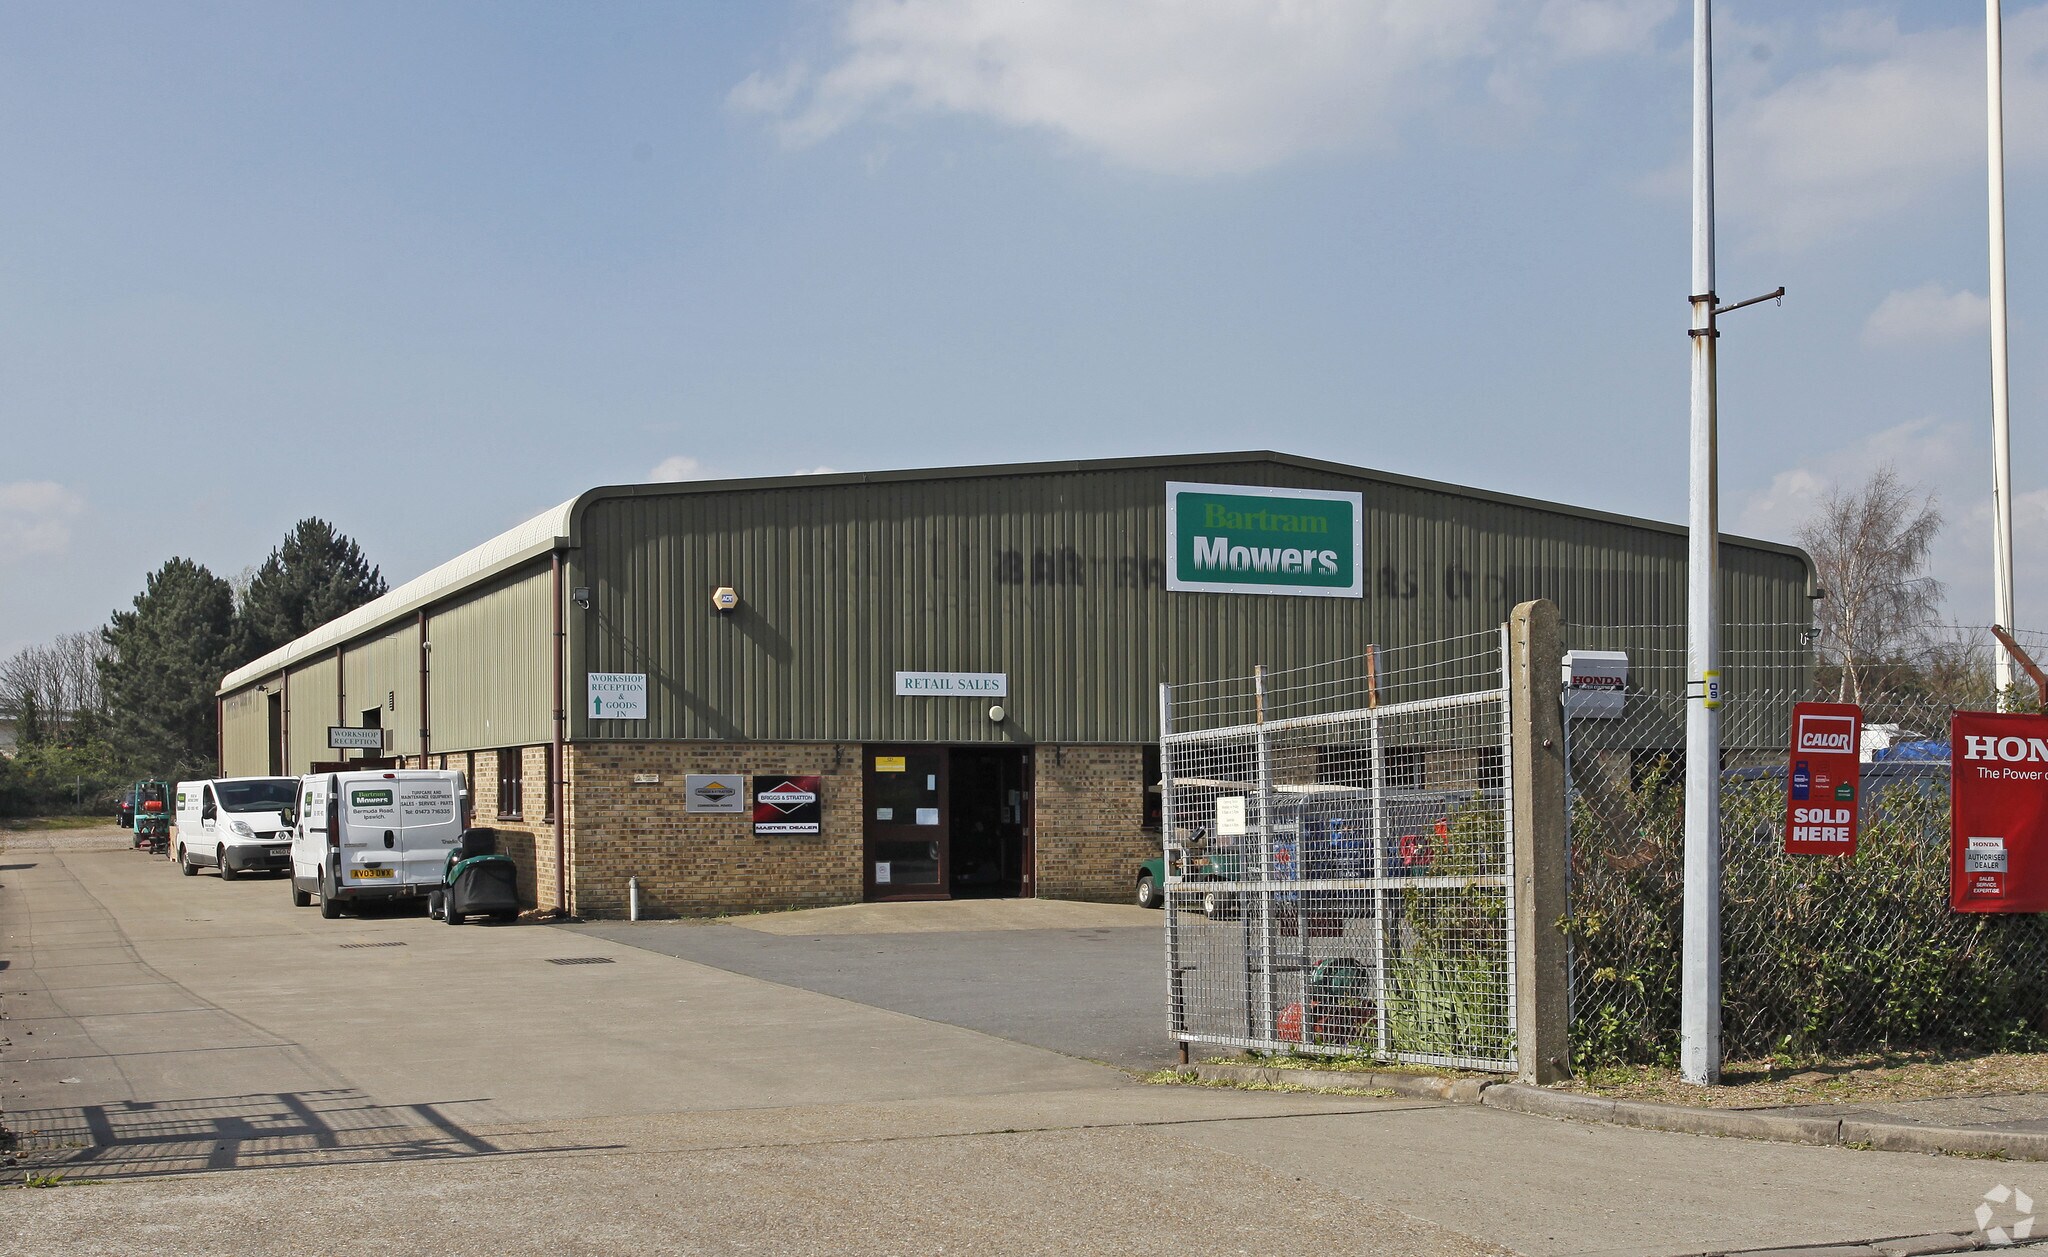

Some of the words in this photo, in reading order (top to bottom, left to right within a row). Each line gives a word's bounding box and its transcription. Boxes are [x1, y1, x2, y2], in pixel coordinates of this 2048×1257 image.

[1204, 503, 1328, 534] Bartram
[1193, 535, 1338, 575] Mowers
[591, 674, 643, 682] WORKSHOP
[1572, 676, 1624, 684] HONDA
[591, 683, 643, 691] RECEPTION
[905, 677, 953, 690] RETAIL
[958, 679, 999, 691] SALES
[606, 701, 638, 709] GOODS
[616, 710, 627, 718] IN
[1803, 732, 1849, 750] CALOR
[1976, 766, 2000, 779] The
[2003, 767, 2042, 780] Power
[1793, 808, 1850, 824] SOLD
[1793, 826, 1850, 842] HERE
[1968, 853, 2006, 861] AUTHORISED
[1974, 861, 1999, 869] DEALER
[354, 870, 374, 878] AV03
